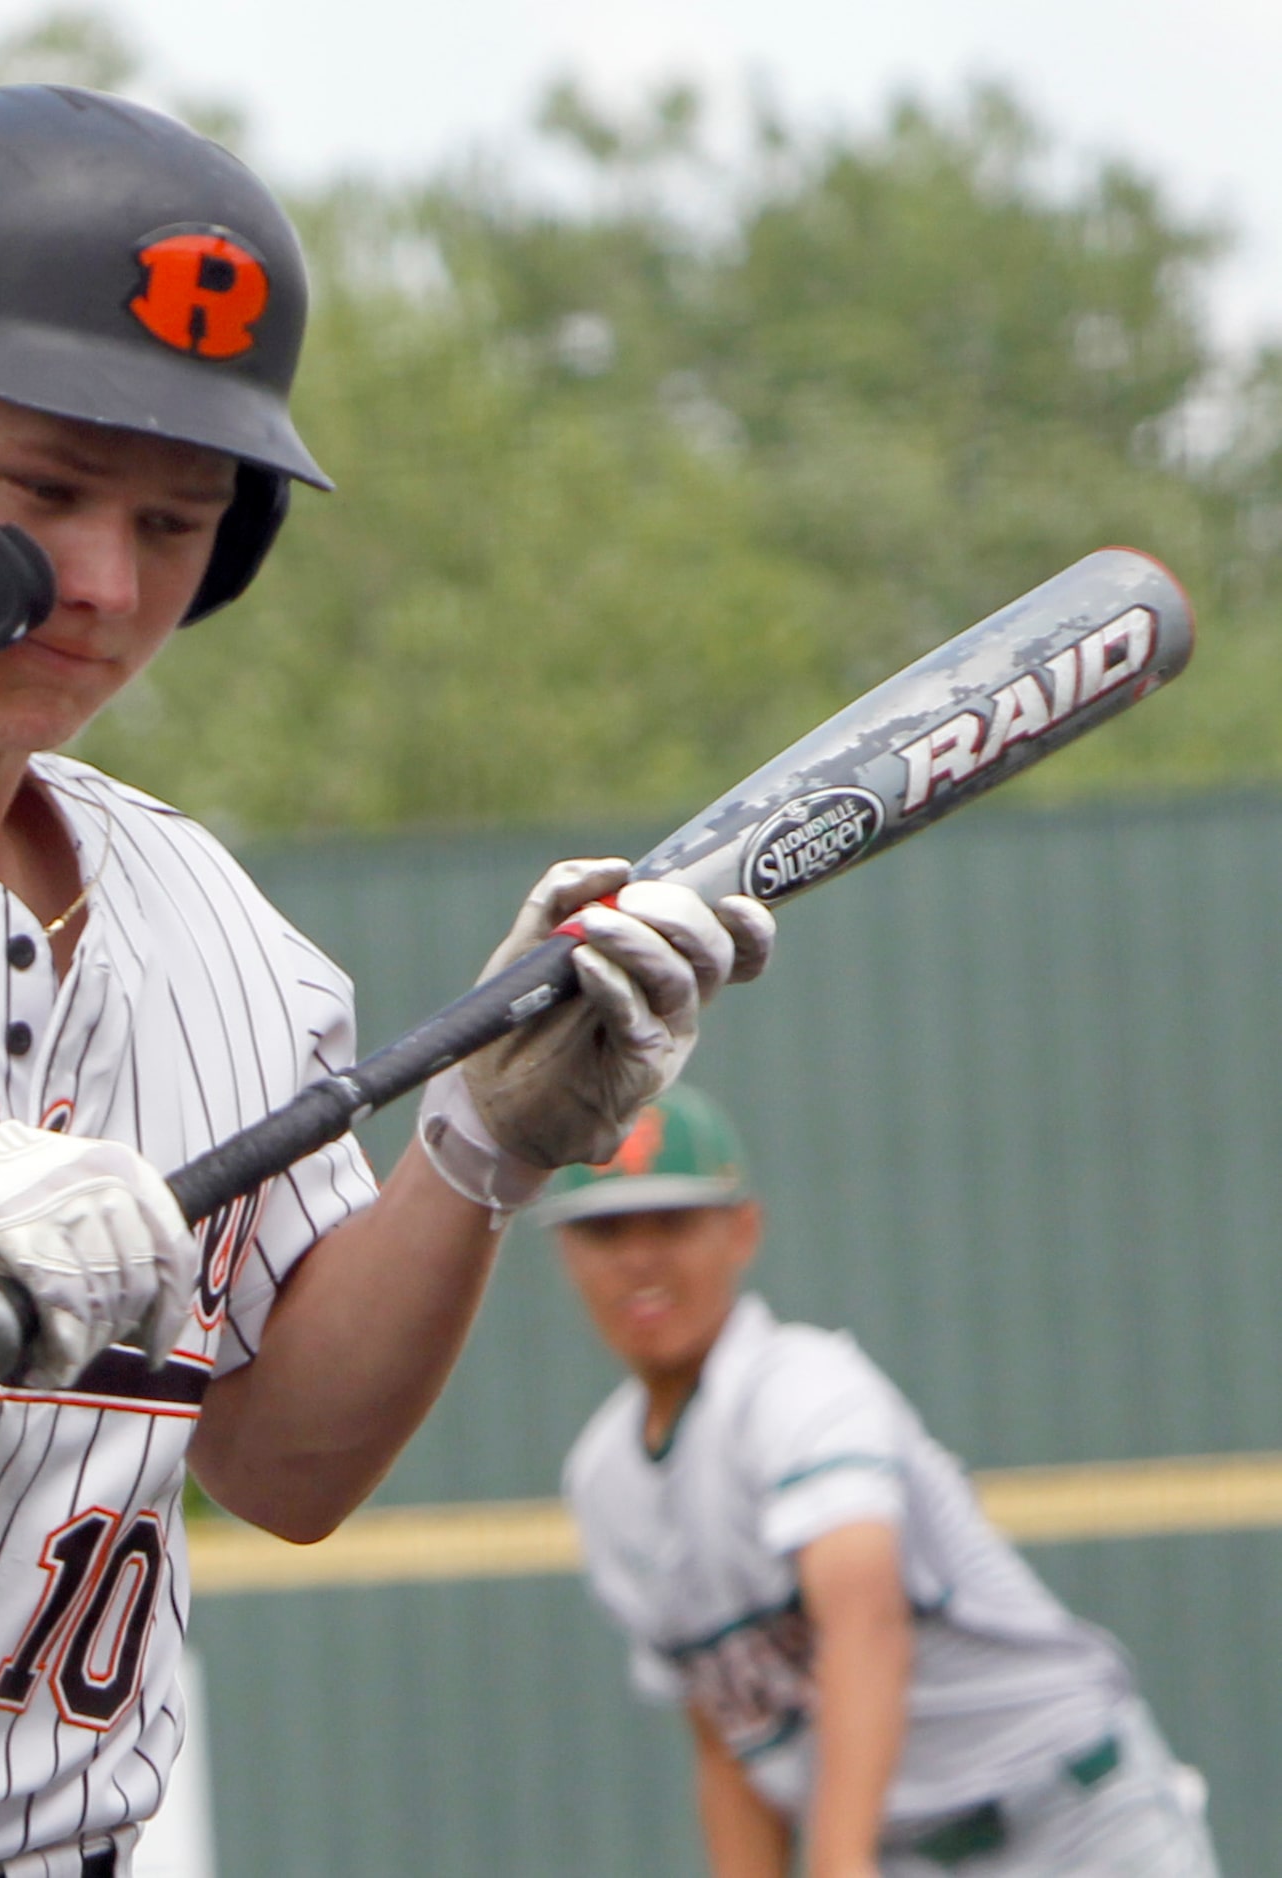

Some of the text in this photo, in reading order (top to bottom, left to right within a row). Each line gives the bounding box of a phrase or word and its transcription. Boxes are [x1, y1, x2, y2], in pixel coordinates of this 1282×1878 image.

[128, 234, 270, 358] R
[896, 603, 1158, 818] RAID
[756, 808, 874, 895] Slugger
[778, 799, 859, 854] LOUISVILLE
